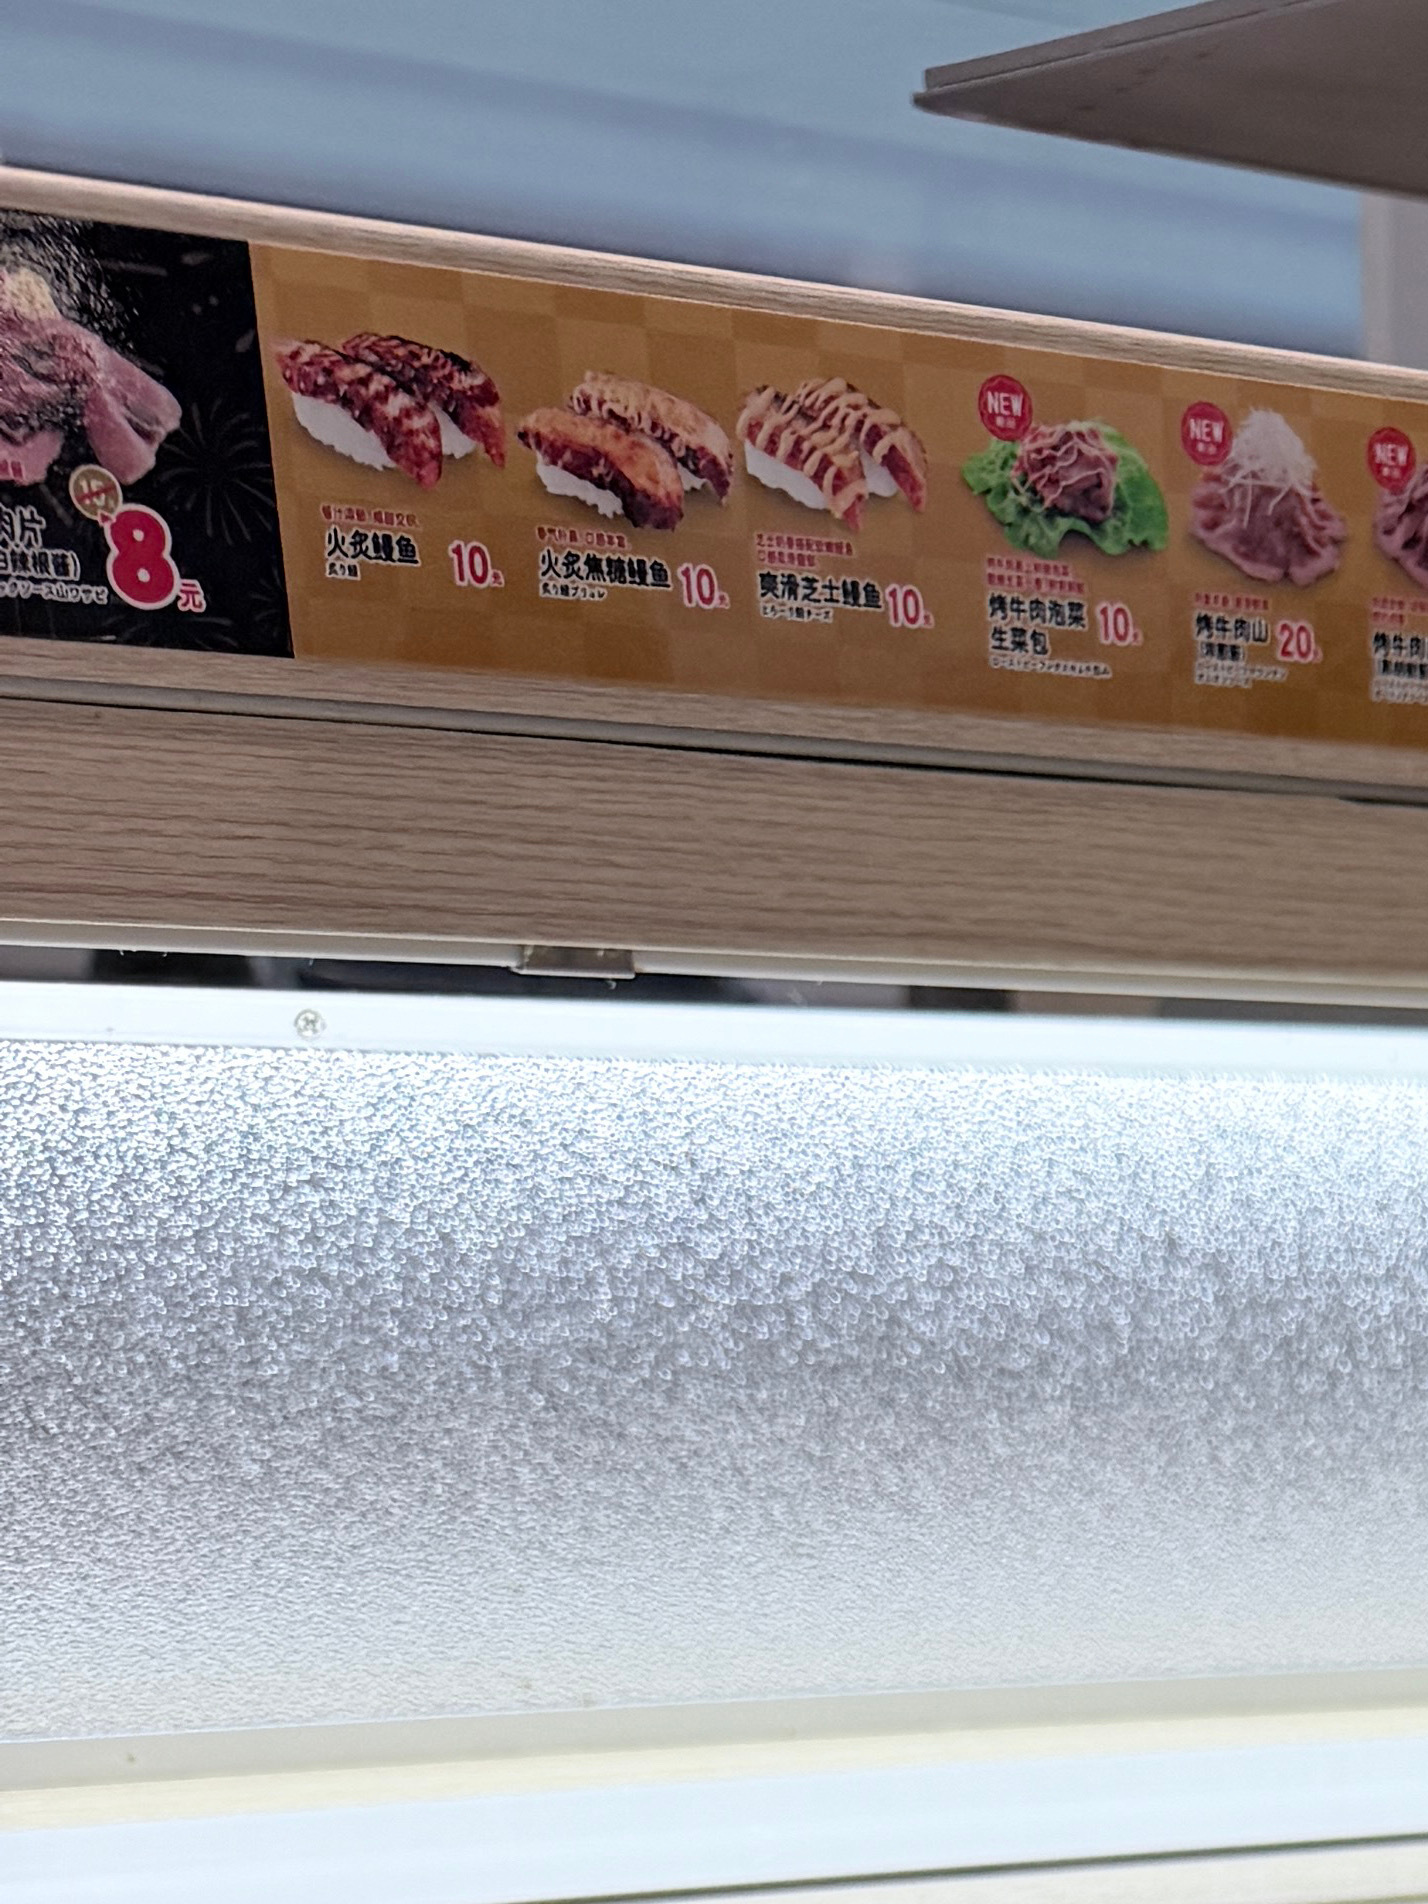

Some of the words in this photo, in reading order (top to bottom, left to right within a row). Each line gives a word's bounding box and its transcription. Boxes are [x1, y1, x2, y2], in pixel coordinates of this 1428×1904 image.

[987, 391, 1023, 417] NEW
[1189, 419, 1224, 443] NEW
[1373, 443, 1408, 467] NEW
[327, 527, 420, 565] 火炙鳗鱼
[540, 549, 671, 589] 火炙焦糖鳗鱼
